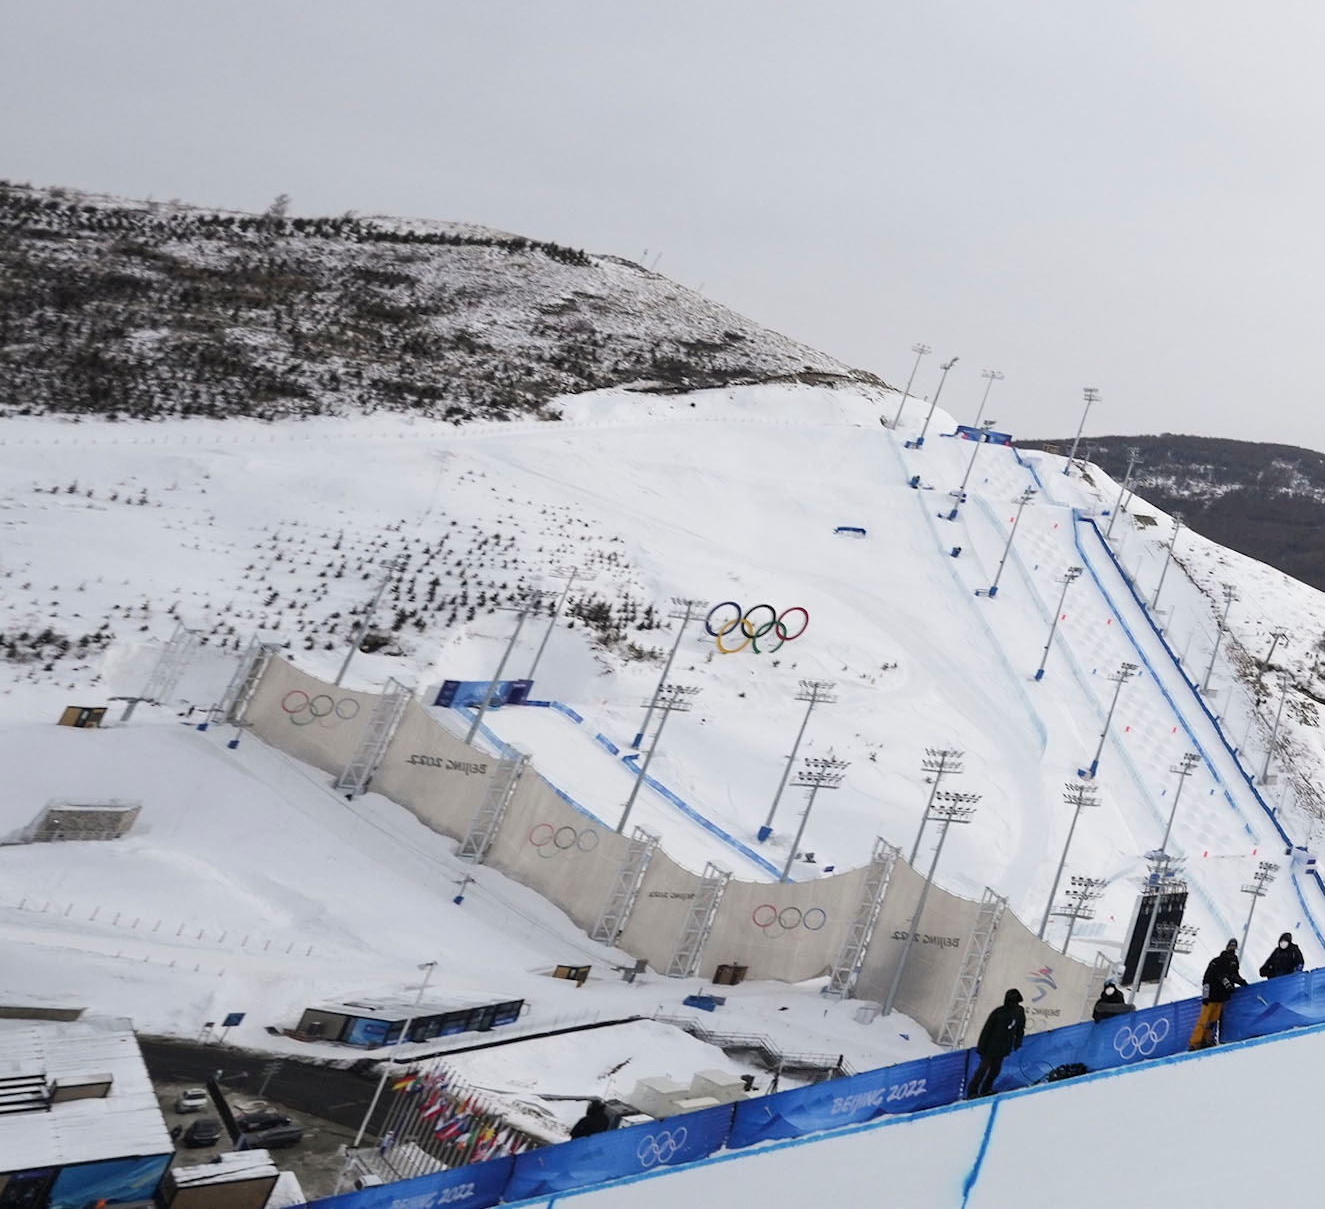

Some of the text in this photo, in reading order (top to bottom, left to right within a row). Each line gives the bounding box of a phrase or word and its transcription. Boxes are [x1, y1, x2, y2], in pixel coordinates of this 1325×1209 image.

[831, 1078, 927, 1117] BEIJING 2022
[437, 1182, 475, 1205] 2022
